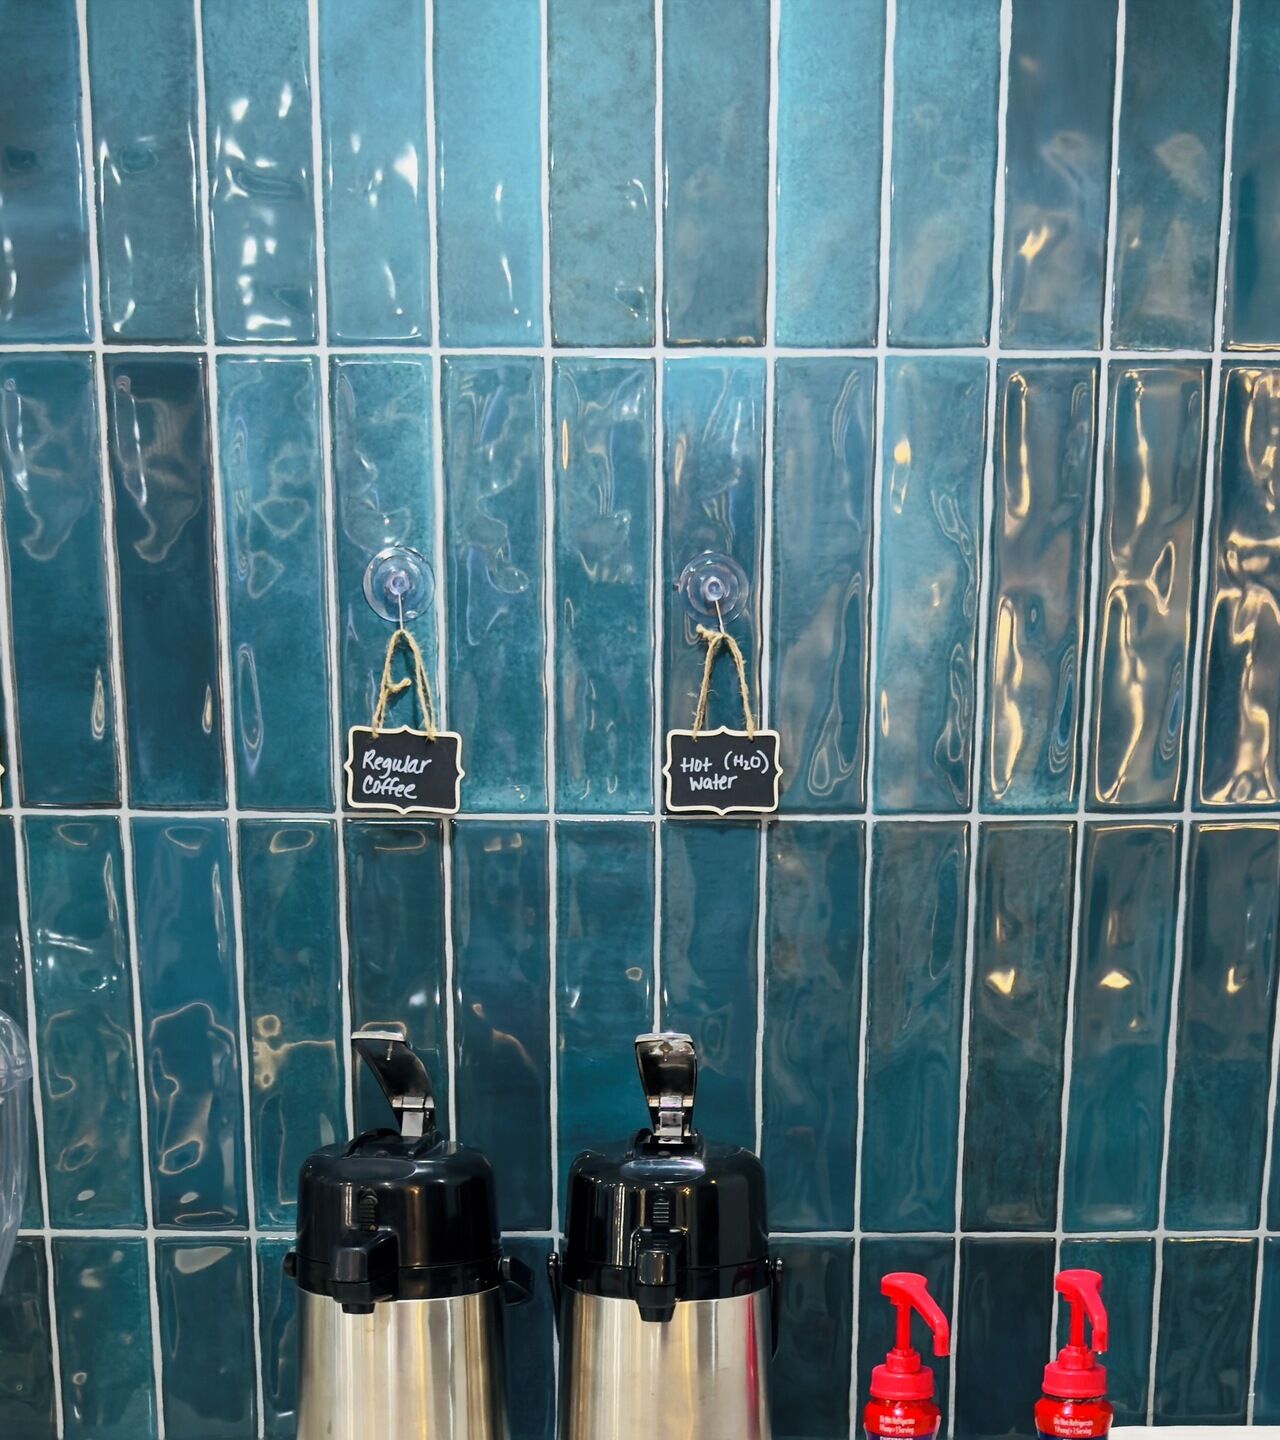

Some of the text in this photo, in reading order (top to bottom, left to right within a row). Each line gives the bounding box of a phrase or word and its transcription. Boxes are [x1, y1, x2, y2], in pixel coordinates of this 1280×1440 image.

[362, 749, 433, 780] Regular
[680, 757, 713, 773] Hot
[362, 775, 418, 800] Coffee
